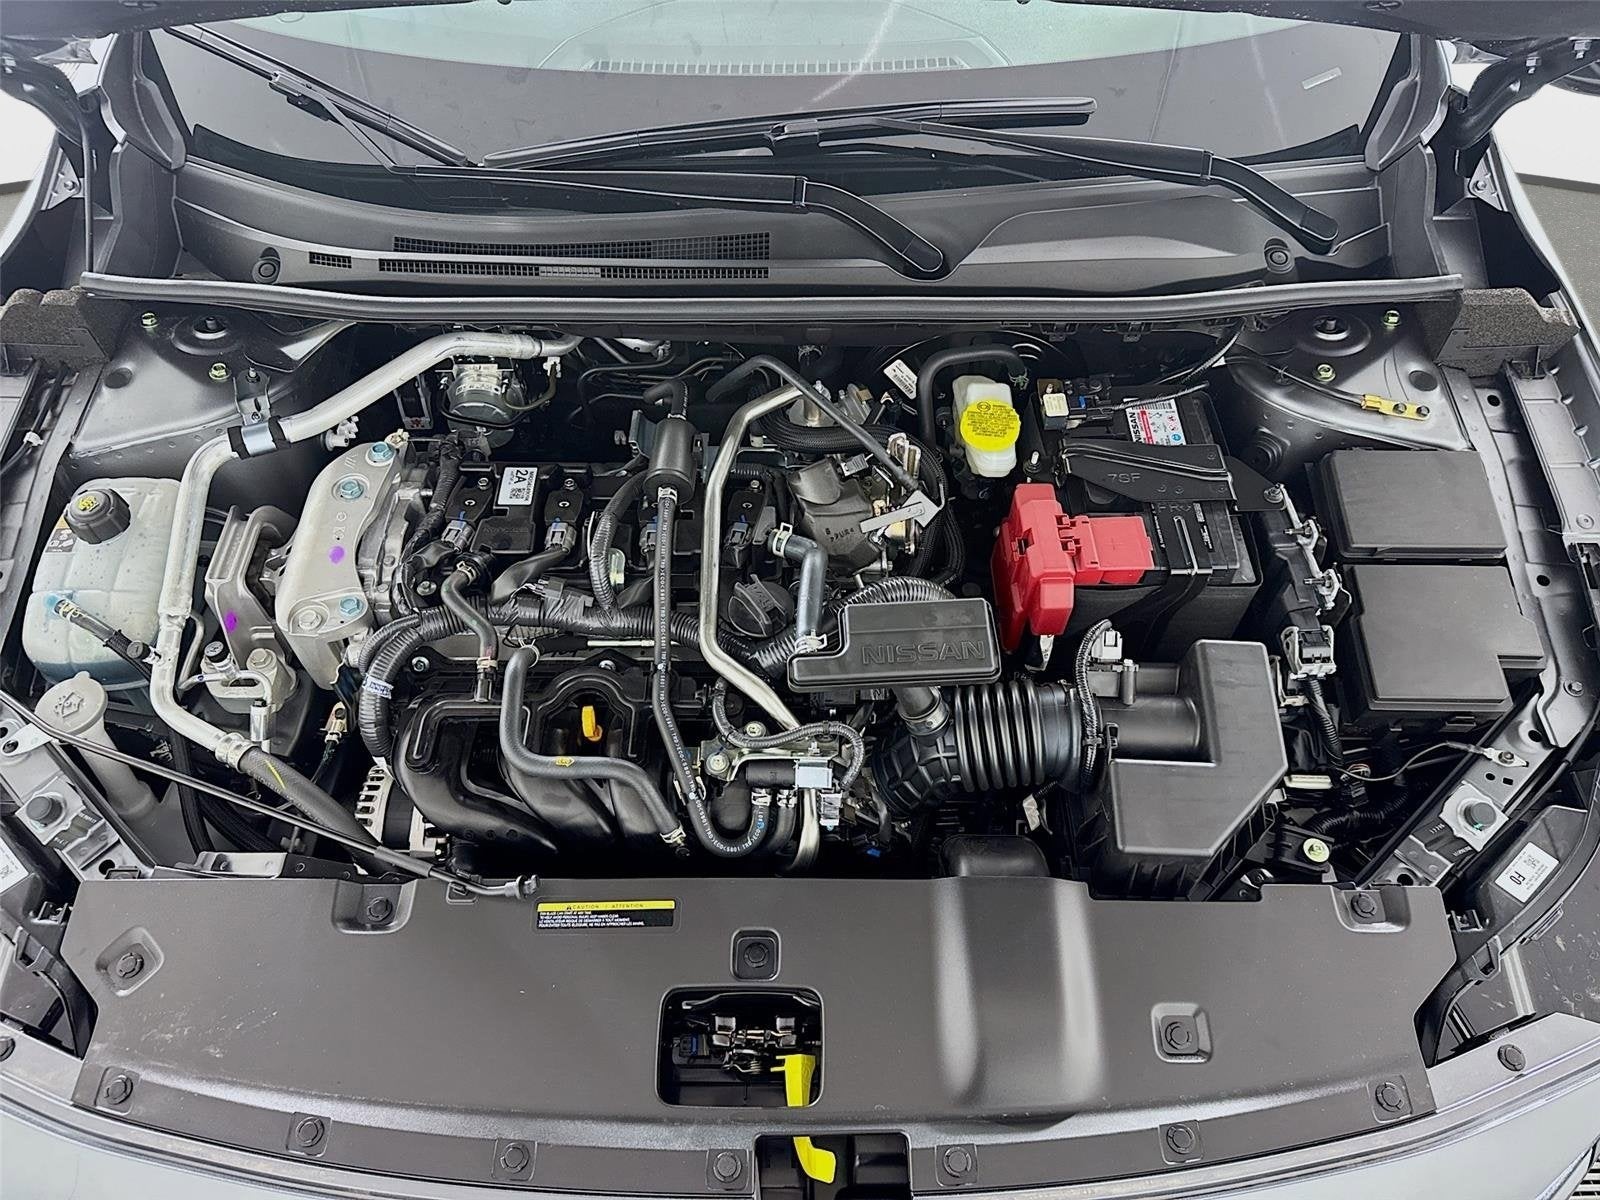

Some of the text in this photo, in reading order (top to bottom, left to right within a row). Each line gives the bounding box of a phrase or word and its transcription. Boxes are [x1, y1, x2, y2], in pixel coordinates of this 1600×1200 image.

[1129, 411, 1143, 443] NISSAN
[513, 469, 529, 484] 2A
[1107, 472, 1141, 484] 7SF
[861, 640, 986, 666] NISSAN
